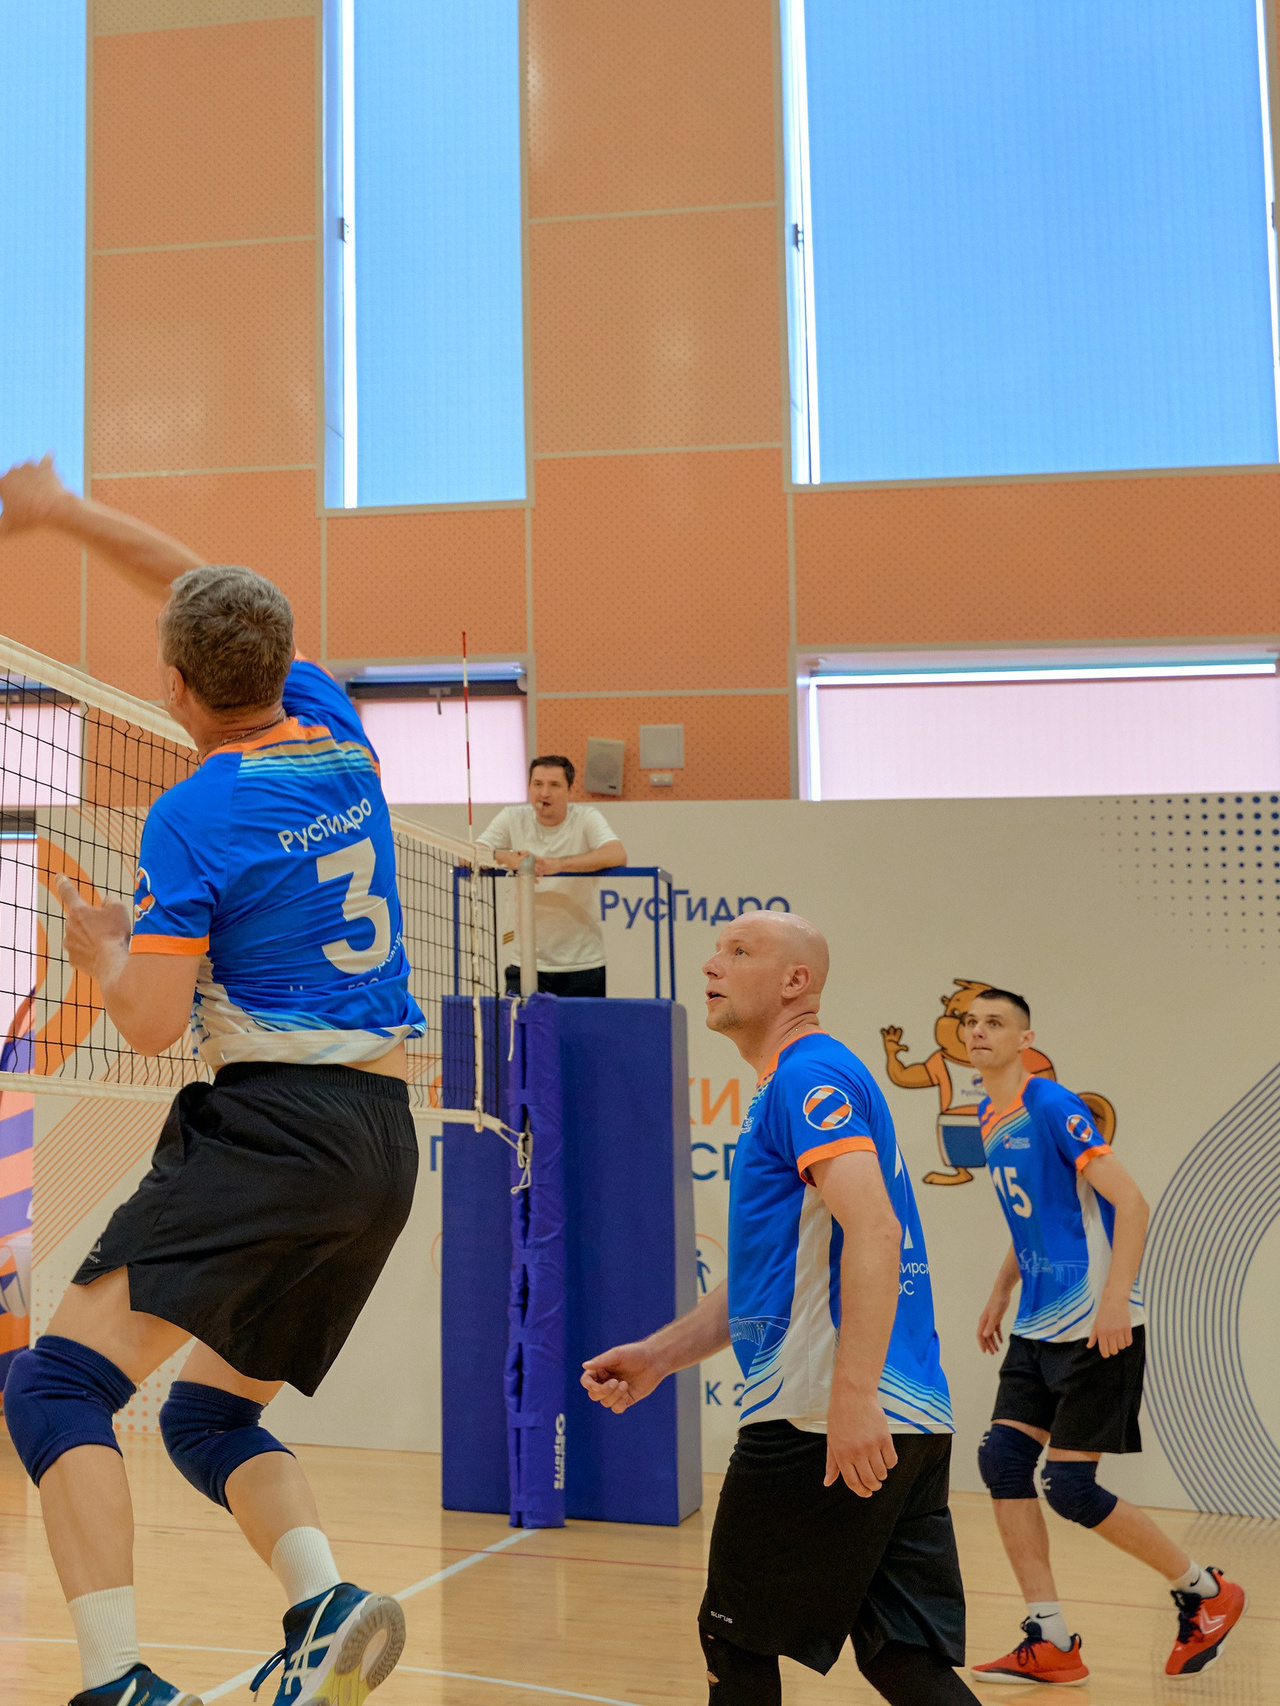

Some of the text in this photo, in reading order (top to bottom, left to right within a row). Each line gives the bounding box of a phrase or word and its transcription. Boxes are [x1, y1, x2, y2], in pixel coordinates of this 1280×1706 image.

[277, 798, 372, 853] РусГидро
[316, 836, 391, 975] 3
[992, 1166, 1032, 1219] 15
